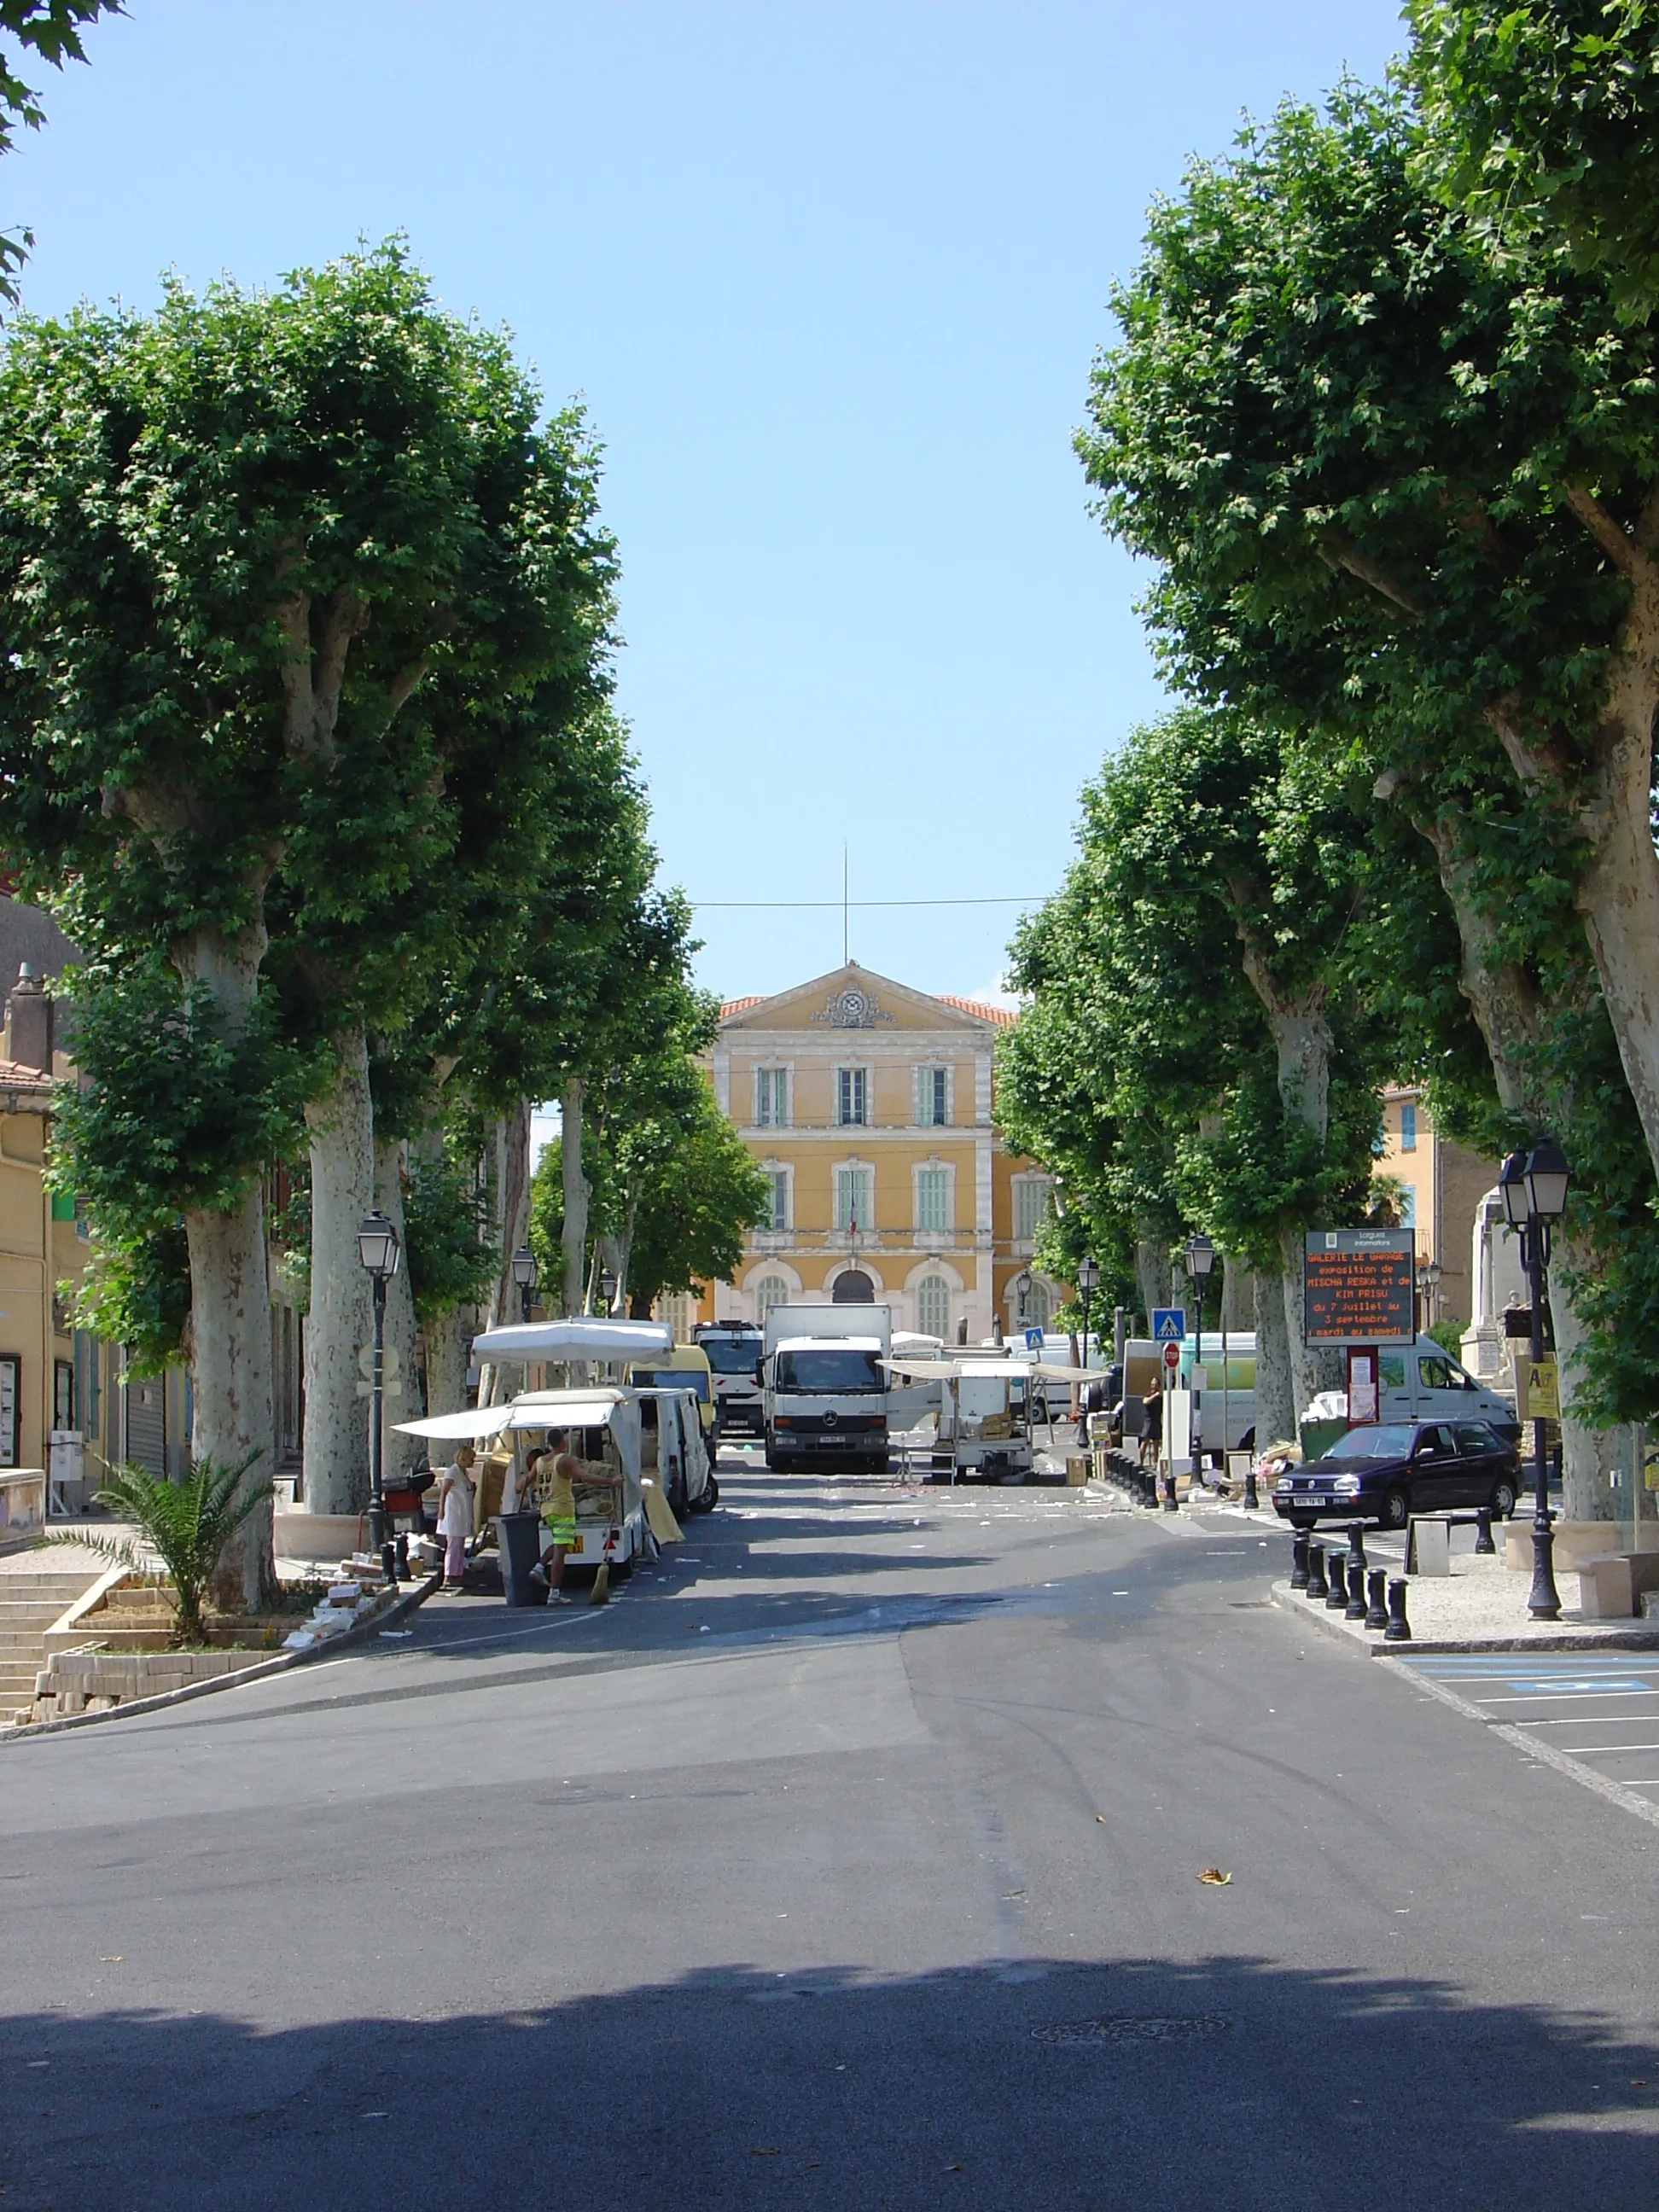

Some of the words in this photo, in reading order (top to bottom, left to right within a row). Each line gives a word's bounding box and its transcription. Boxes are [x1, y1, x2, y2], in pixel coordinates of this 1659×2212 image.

[1307, 1253, 1348, 1262] GALERIE
[1352, 1253, 1365, 1261] LE
[1370, 1251, 1404, 1261] GARAGE
[1318, 1266, 1376, 1274] exposition
[1381, 1265, 1394, 1273] de
[1307, 1278, 1342, 1287] MISCHA
[1347, 1277, 1377, 1286] RESKA
[1398, 1277, 1411, 1285] de
[1336, 1289, 1353, 1298] KIM
[1359, 1289, 1388, 1298] PRISU
[1313, 1303, 1325, 1312] du
[1330, 1302, 1337, 1312] 7
[1324, 1314, 1331, 1324] 3
[1336, 1315, 1388, 1324] septembre
[1316, 1328, 1345, 1336] mardi
[1367, 1326, 1400, 1336] samedi
[1166, 1351, 1178, 1359] STOP
